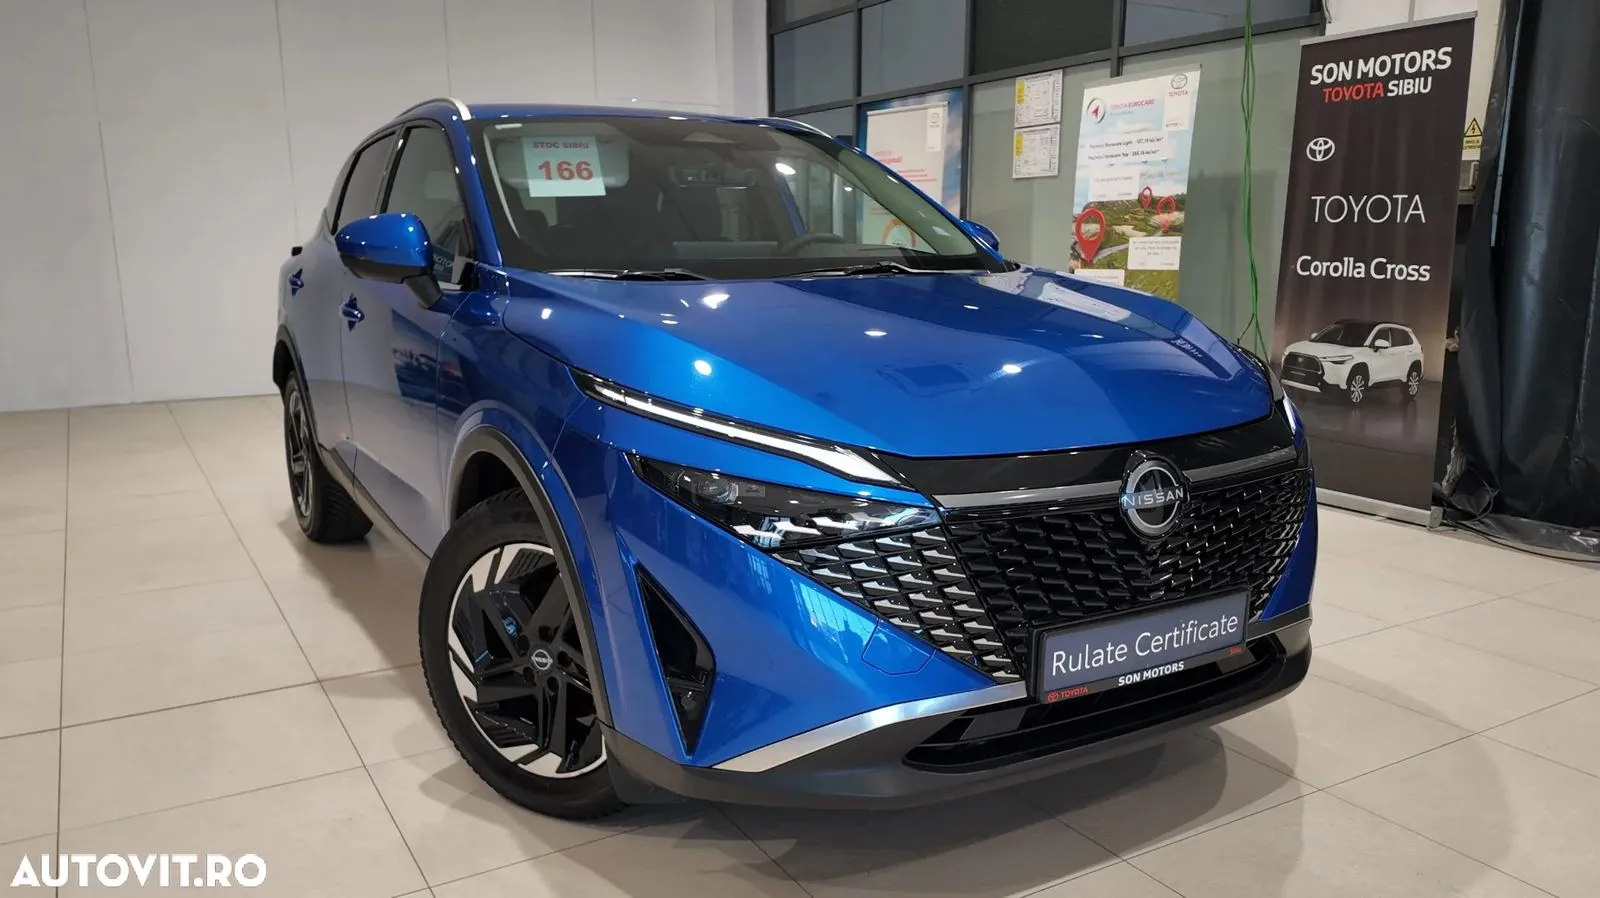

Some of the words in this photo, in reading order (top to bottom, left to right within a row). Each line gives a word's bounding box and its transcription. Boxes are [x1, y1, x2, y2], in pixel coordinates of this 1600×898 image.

[1309, 59, 1353, 85] SON
[1356, 46, 1453, 79] MOTORS
[1323, 82, 1385, 104] TOYOTA
[1387, 76, 1432, 97] SIBIU
[533, 141, 560, 149] STOC
[538, 160, 594, 181] 166
[1311, 194, 1426, 223] TOYOTA
[1296, 255, 1365, 279] Corolla
[1370, 257, 1431, 282] Cross
[1123, 487, 1184, 507] NISSAN
[1051, 642, 1128, 676] Rulate
[1135, 613, 1239, 656] Certificate
[1118, 672, 1141, 687] SON
[1142, 661, 1185, 681] MOTORS
[1060, 686, 1089, 699] TOYOTA
